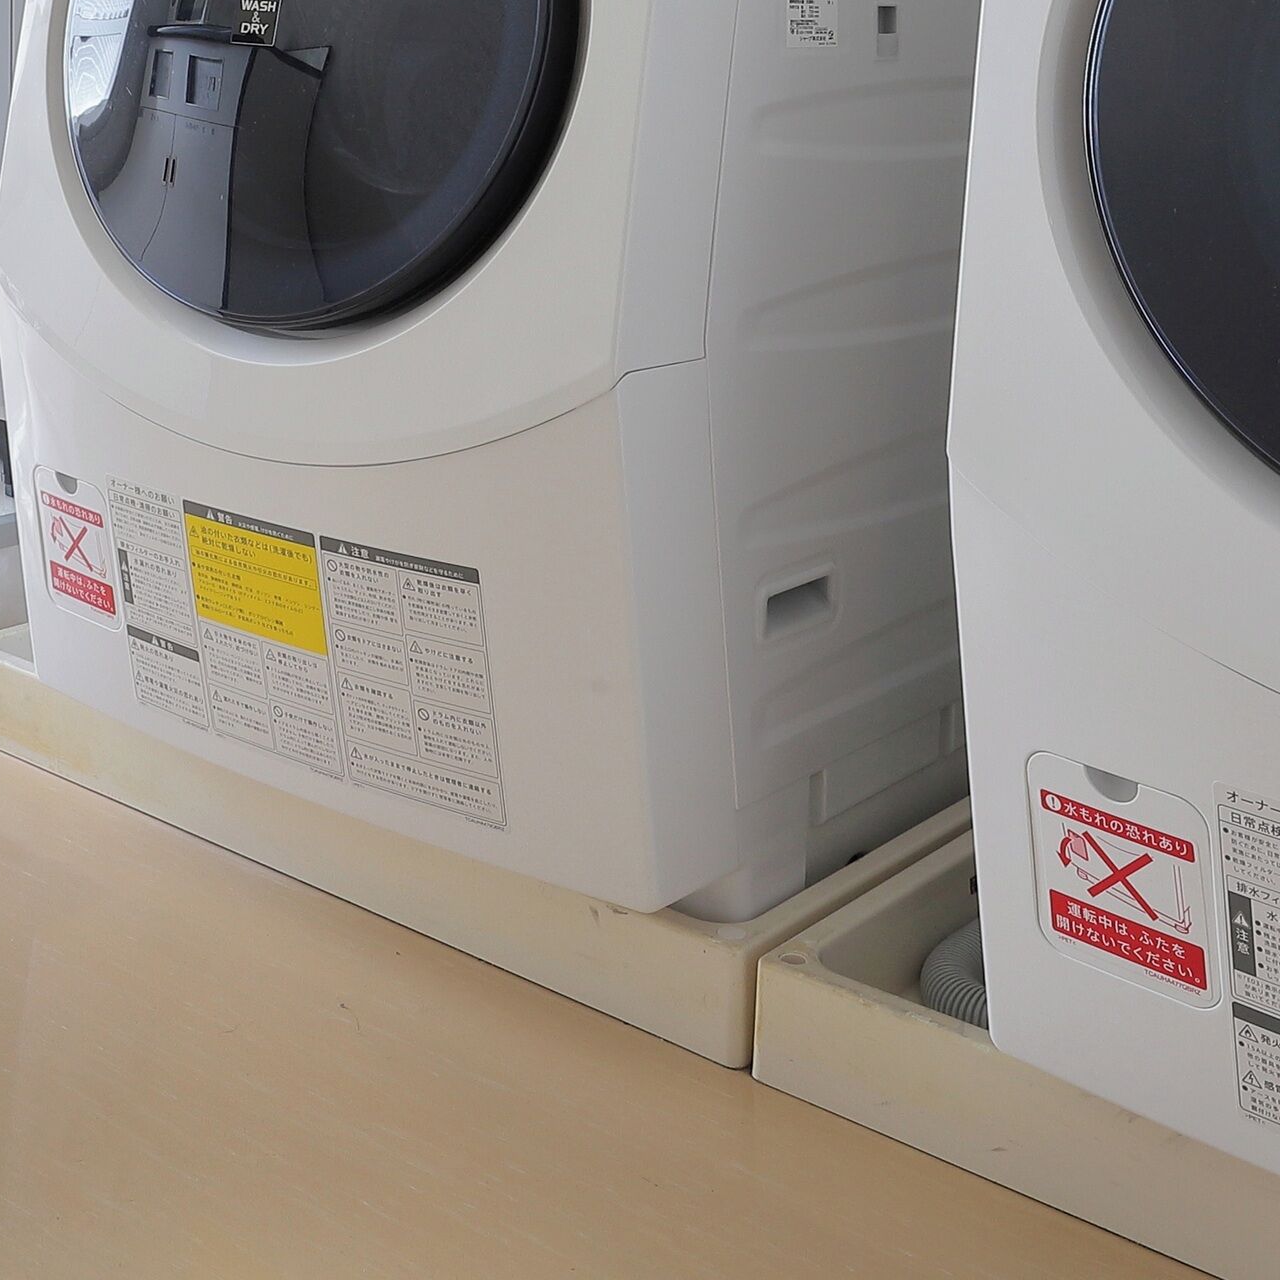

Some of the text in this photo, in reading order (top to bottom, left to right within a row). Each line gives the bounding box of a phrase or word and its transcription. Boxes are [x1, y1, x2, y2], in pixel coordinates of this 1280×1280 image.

[241, 0, 277, 12] WASH
[252, 12, 260, 23] &
[240, 23, 269, 34] DRY
[1064, 802, 1188, 856] 水もれの恐れあり
[1067, 902, 1186, 959] 運転中は、ふたを
[1236, 928, 1250, 955] 注意
[1056, 914, 1201, 984] 開けないでください。
